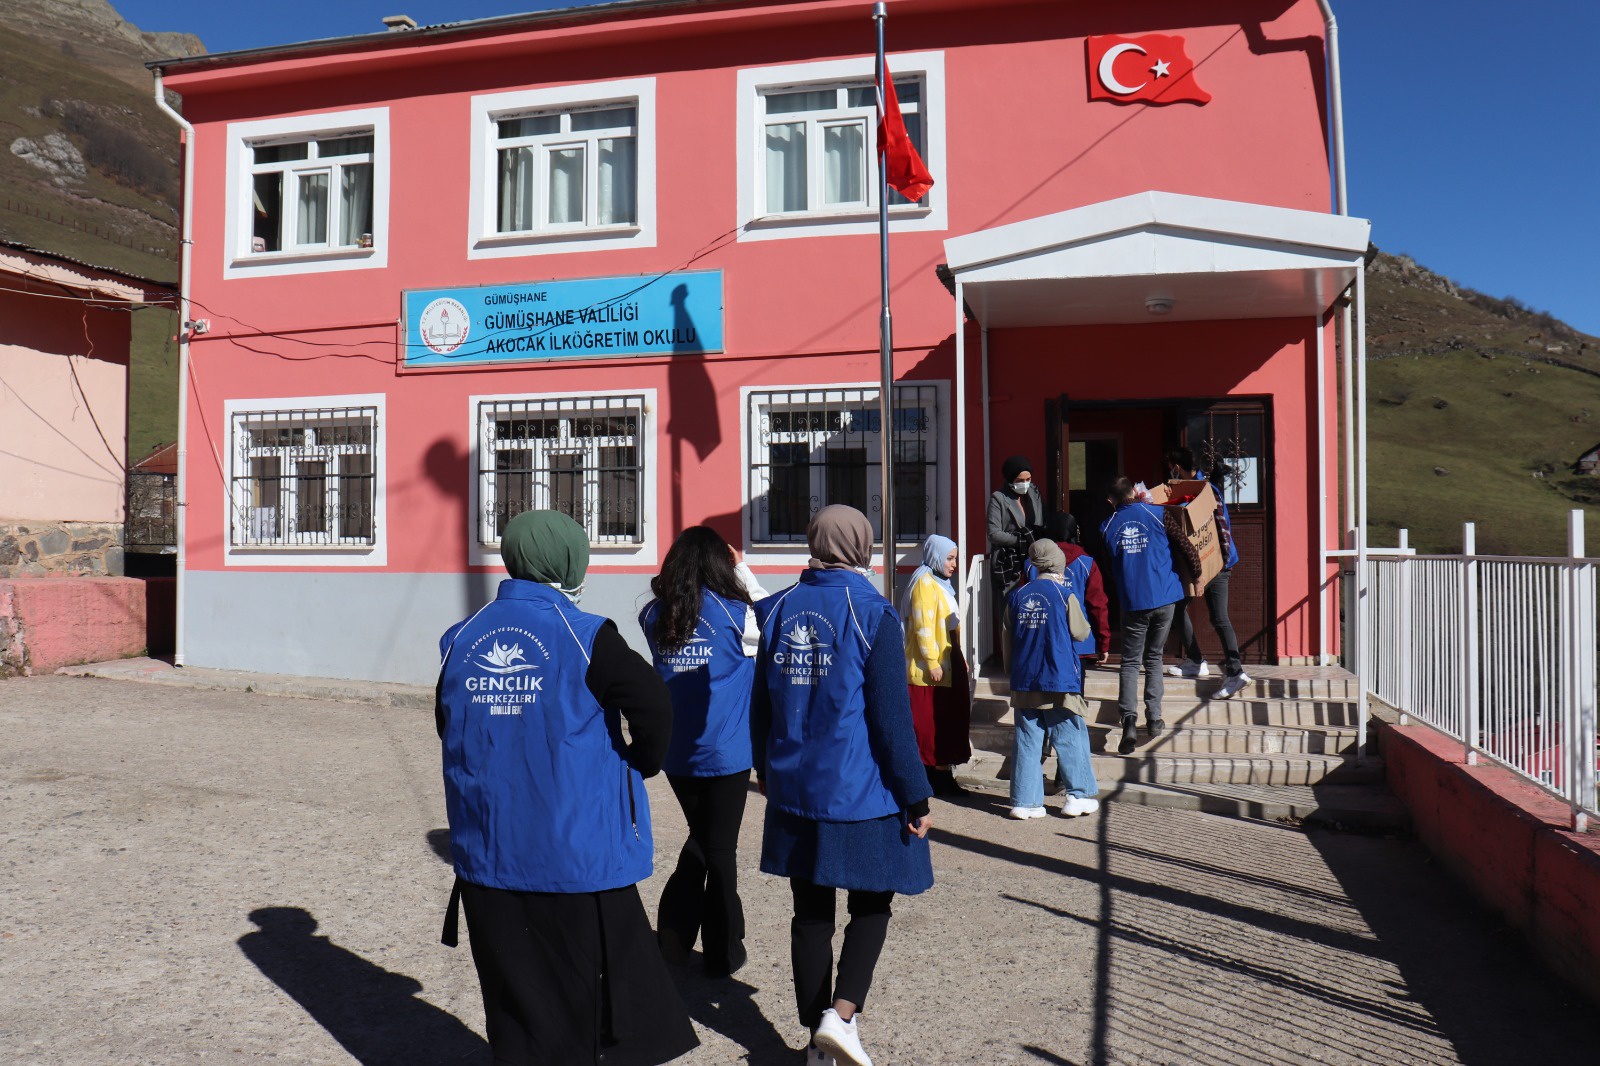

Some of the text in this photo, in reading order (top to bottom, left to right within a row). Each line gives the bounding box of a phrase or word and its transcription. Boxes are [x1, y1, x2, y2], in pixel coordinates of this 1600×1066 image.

[484, 292, 547, 305] GÜMÜŞHANE
[485, 302, 639, 331] GÜMÜŞHANE VALİLİĞİ
[486, 327, 696, 353] AKOCAK İLKÖĞRETİM OKULU
[506, 626, 523, 634] SPOR
[663, 657, 709, 665] MERKEZLERİ
[773, 652, 833, 667] GENÇLİK
[781, 667, 828, 676] MERKEZLERİ
[465, 675, 544, 692] GENÇLİK
[471, 693, 537, 703] MERKEZLERİ
